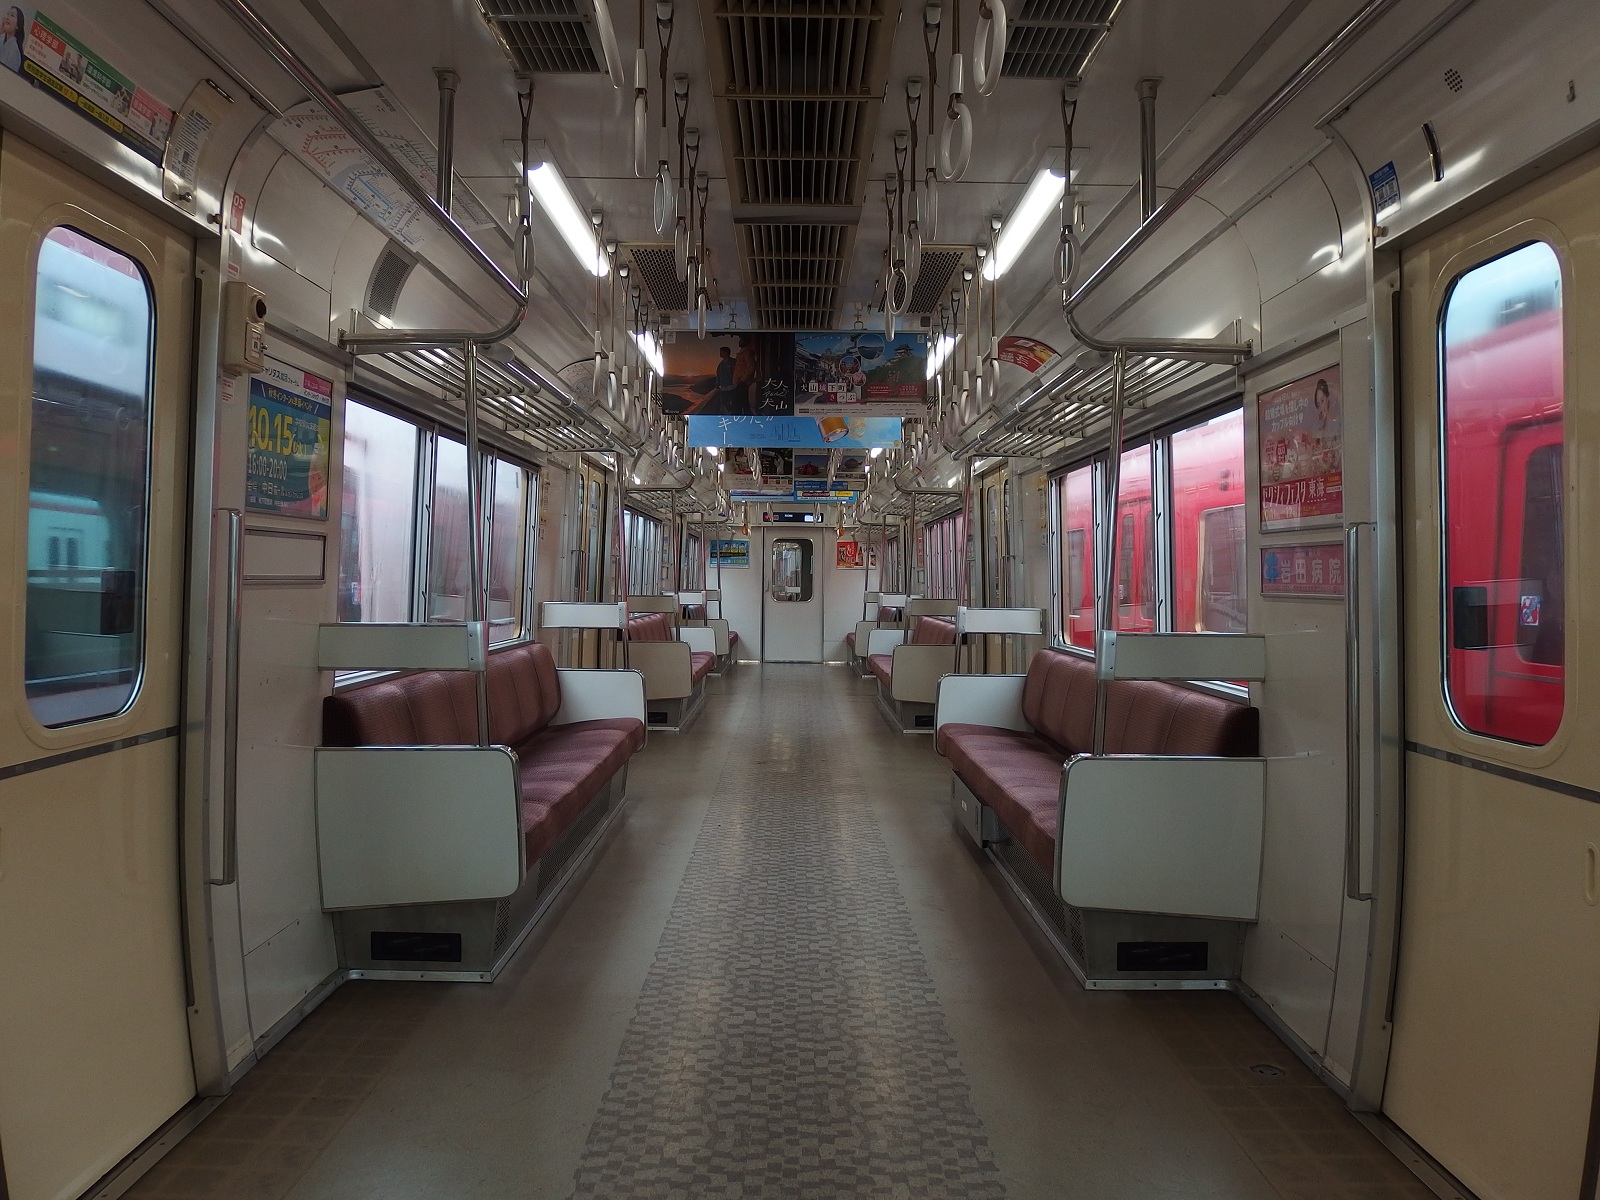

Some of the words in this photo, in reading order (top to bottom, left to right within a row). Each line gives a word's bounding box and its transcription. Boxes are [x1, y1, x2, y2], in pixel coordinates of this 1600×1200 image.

[800, 382, 846, 393] 犬山城下町
[758, 397, 789, 410] 犬山
[829, 393, 855, 402] きっぷ
[248, 405, 294, 456] 10.15
[1308, 477, 1325, 498] 東海
[1281, 557, 1342, 584] 岩田病院
